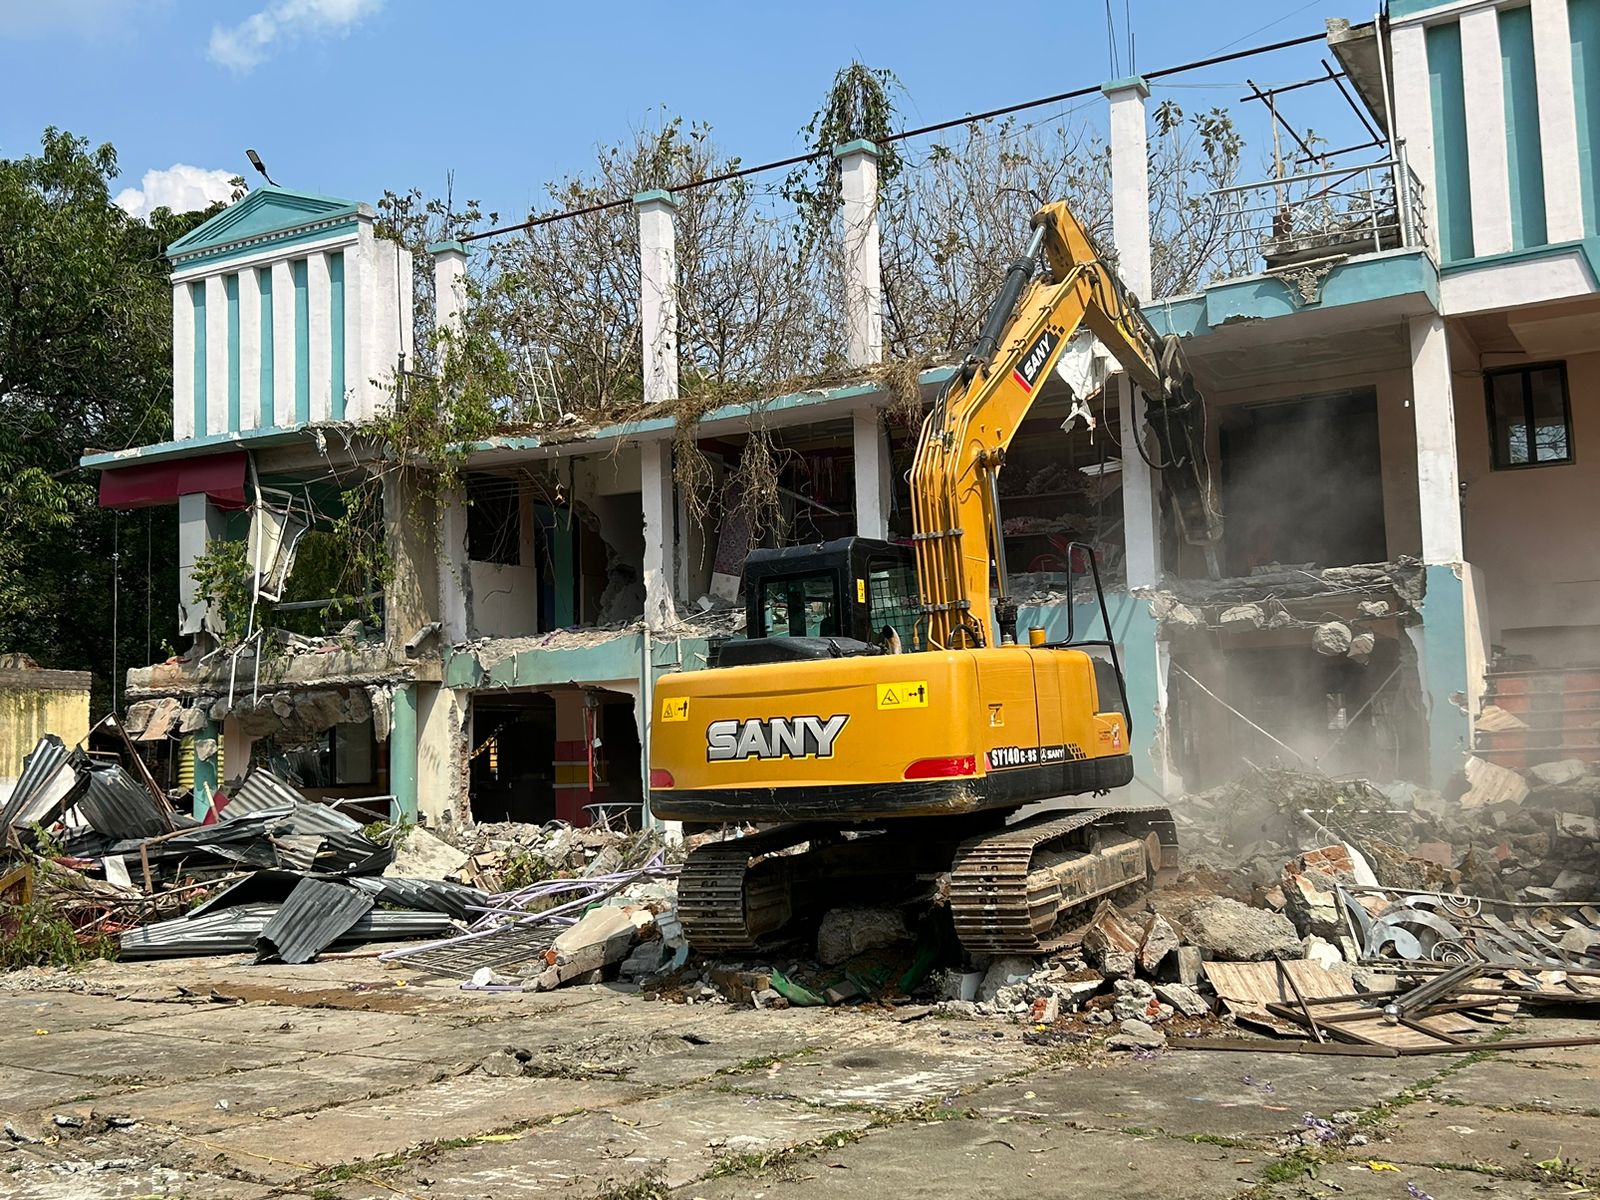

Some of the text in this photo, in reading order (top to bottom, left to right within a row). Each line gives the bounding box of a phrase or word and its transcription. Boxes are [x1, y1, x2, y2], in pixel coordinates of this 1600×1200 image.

[1023, 333, 1051, 381] SANY
[708, 715, 849, 760] SANY
[1047, 748, 1064, 759] SANY
